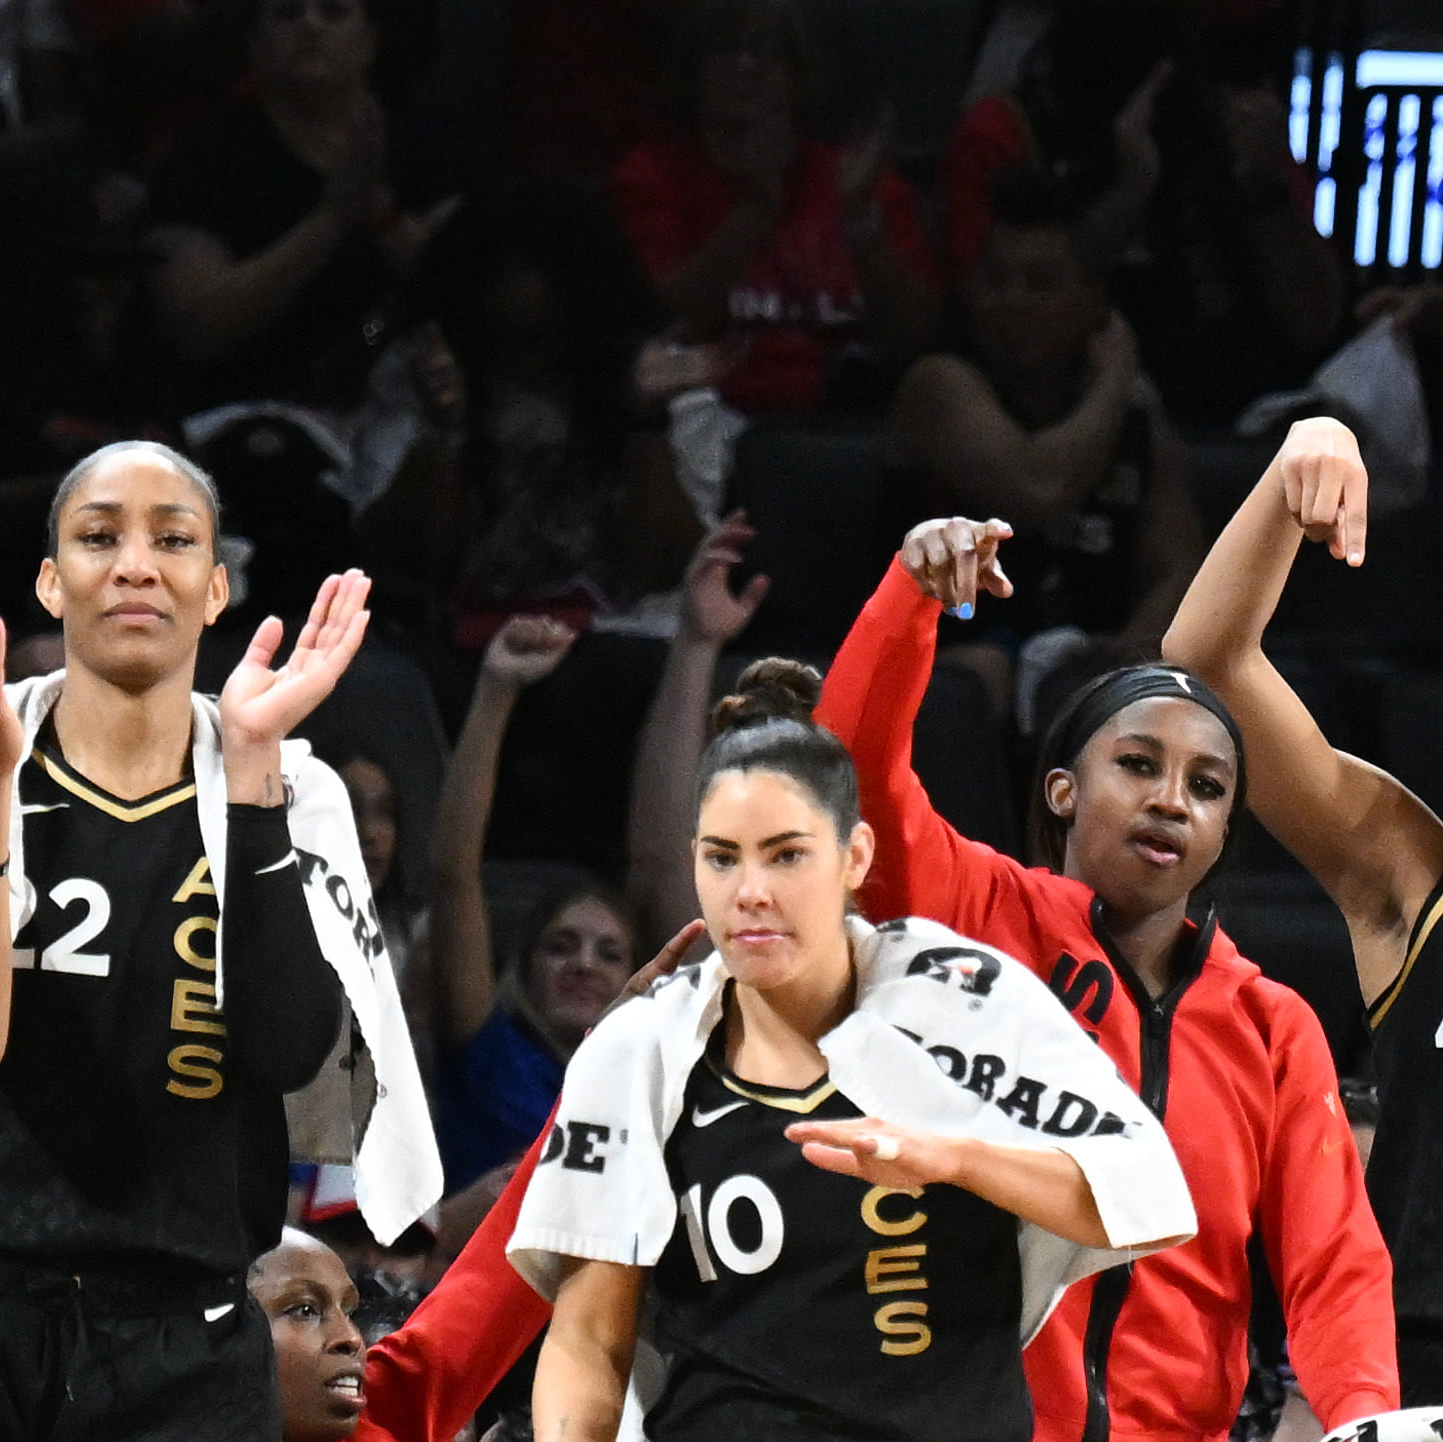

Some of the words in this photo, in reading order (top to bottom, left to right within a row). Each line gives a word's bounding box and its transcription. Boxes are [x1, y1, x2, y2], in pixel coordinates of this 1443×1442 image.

[12, 878, 111, 977] 2
[166, 856, 228, 1099] ACES
[891, 1024, 1134, 1138] ORAD
[680, 1173, 784, 1283] 10
